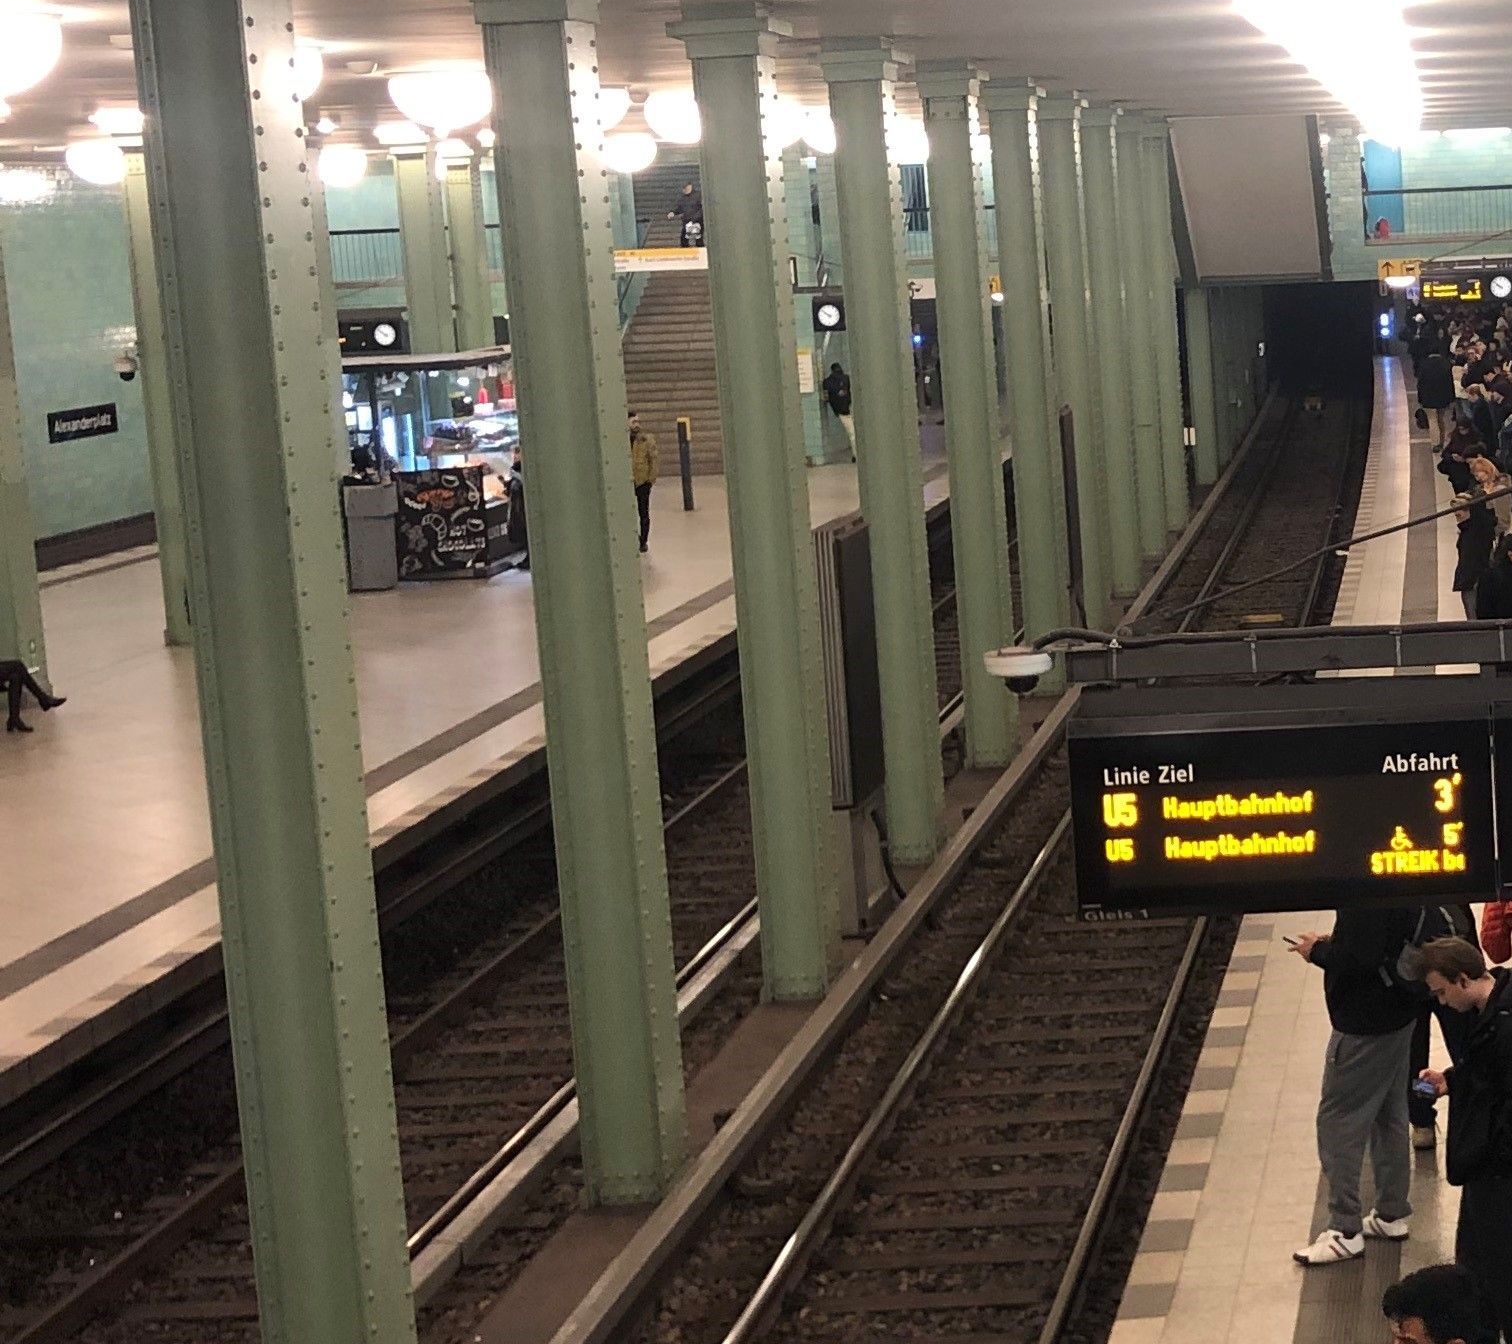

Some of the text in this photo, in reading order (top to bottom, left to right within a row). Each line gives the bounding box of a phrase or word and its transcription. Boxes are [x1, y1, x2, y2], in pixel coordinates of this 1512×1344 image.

[1103, 752, 1460, 787] Linie Ziel Abfahrt
[1103, 792, 1138, 827] U5
[1162, 789, 1314, 821] Hauptbahnhof
[1105, 838, 1135, 862] U5
[1165, 829, 1317, 861] Hauptbahnhof
[1370, 849, 1440, 875] STREIK
[1084, 909, 1133, 922] Gleis
